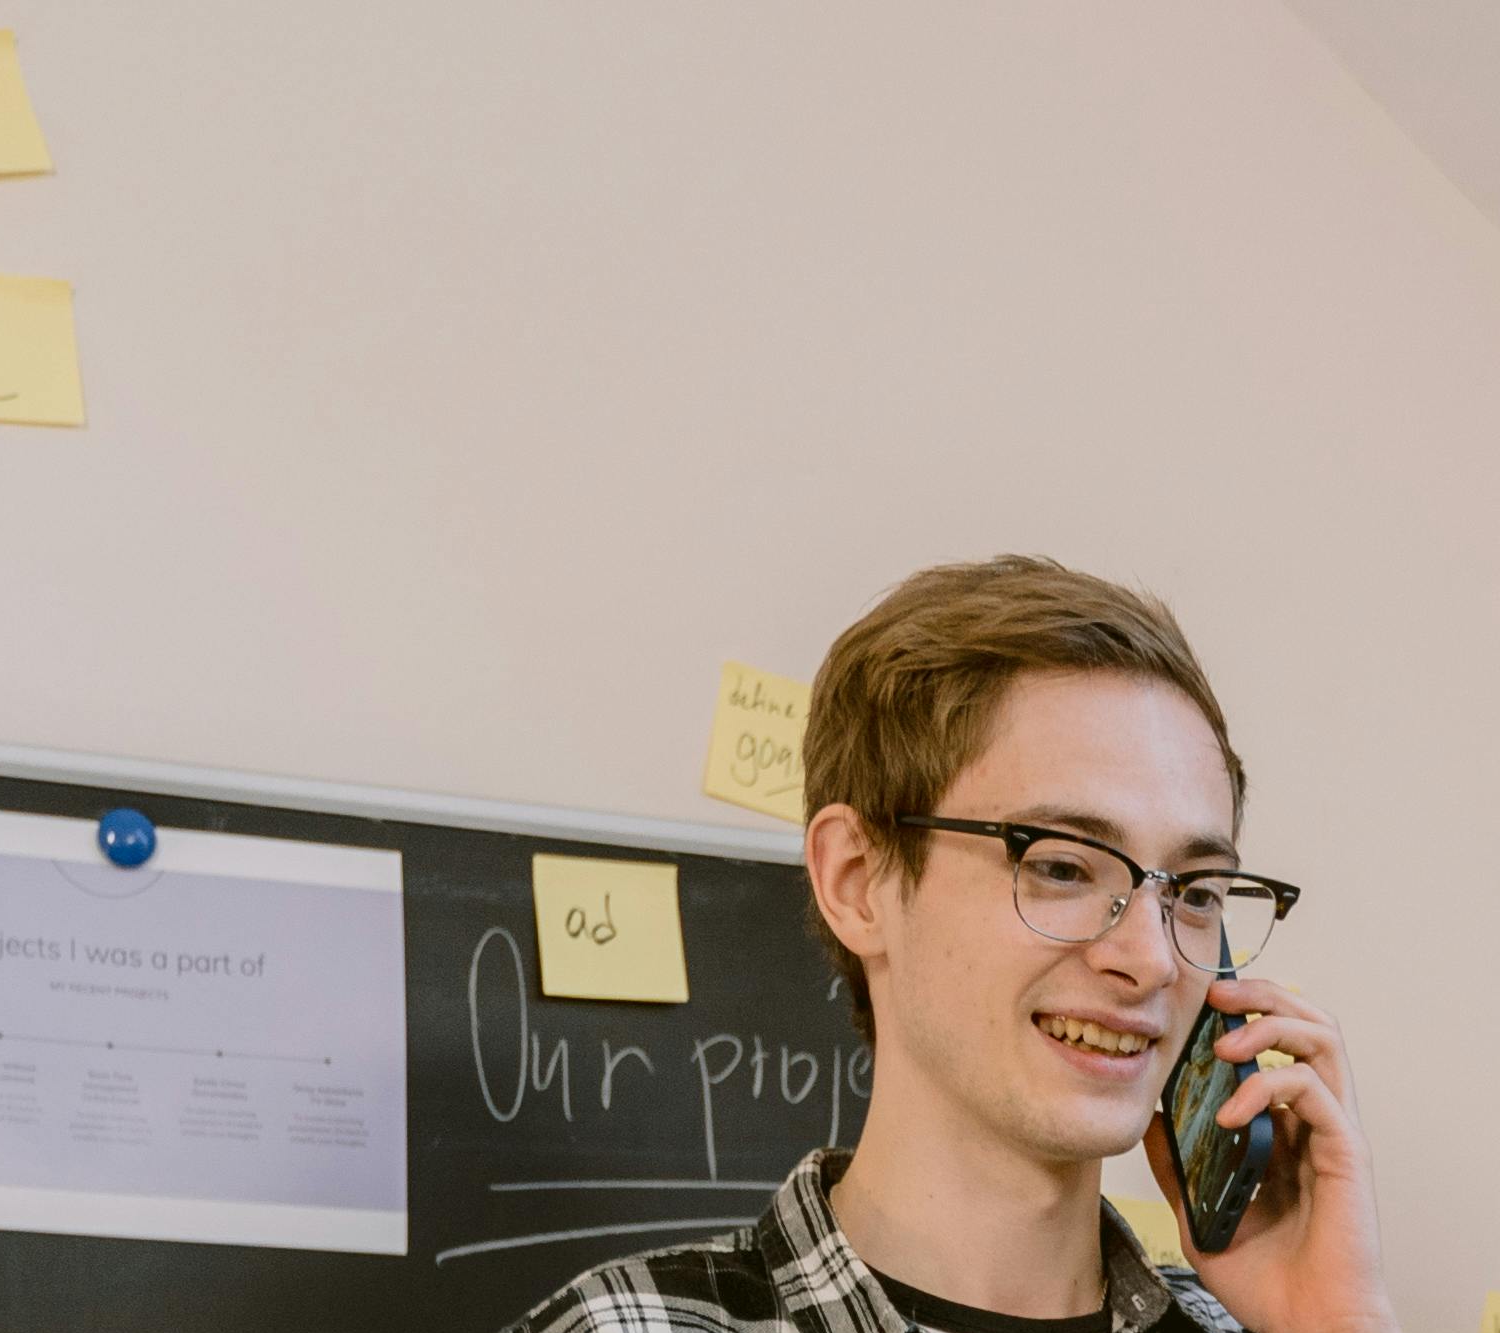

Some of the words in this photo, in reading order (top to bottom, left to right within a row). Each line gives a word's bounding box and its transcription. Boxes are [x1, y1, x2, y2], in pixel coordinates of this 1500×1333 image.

[565, 892, 617, 945] ad
[69, 938, 77, 962] I
[84, 945, 143, 969] was
[150, 949, 169, 972] a
[176, 951, 233, 978] part
[239, 951, 267, 977] of
